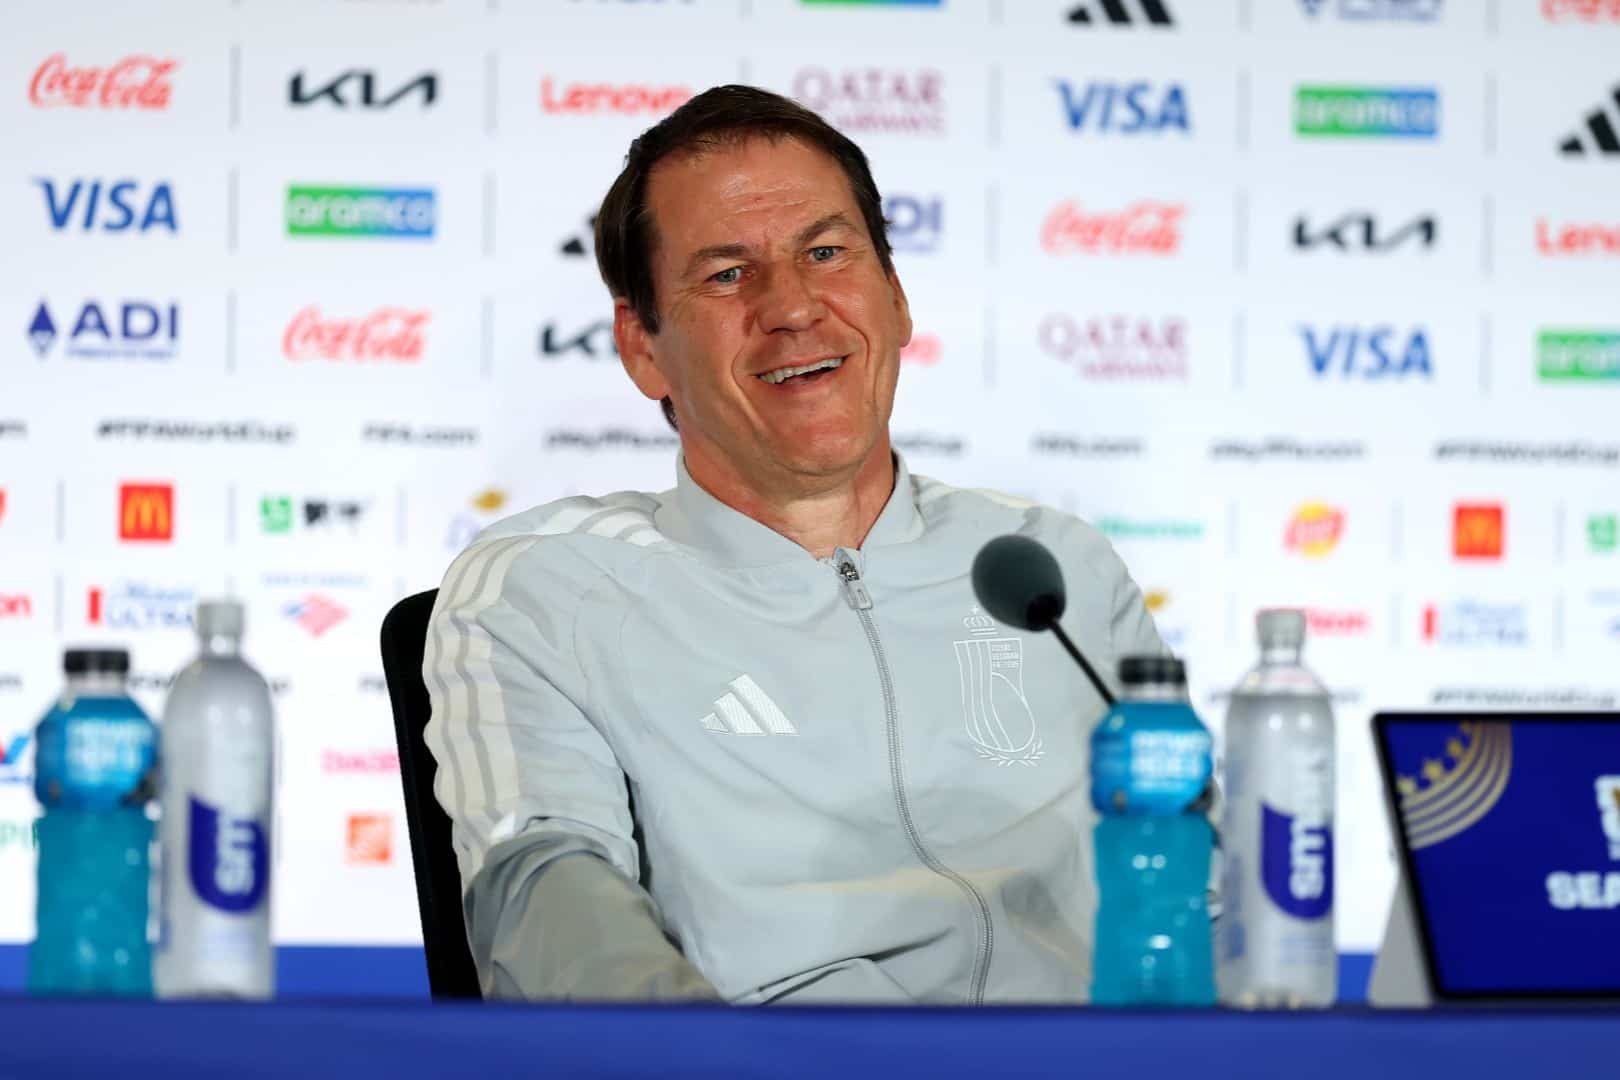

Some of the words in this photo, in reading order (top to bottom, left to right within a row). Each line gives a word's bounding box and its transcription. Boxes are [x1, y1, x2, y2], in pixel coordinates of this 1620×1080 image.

[1053, 79, 1191, 133] VISA
[36, 178, 179, 232] VISA
[884, 197, 942, 236] DI
[70, 300, 180, 342] ADI
[1298, 325, 1436, 379] VISA
